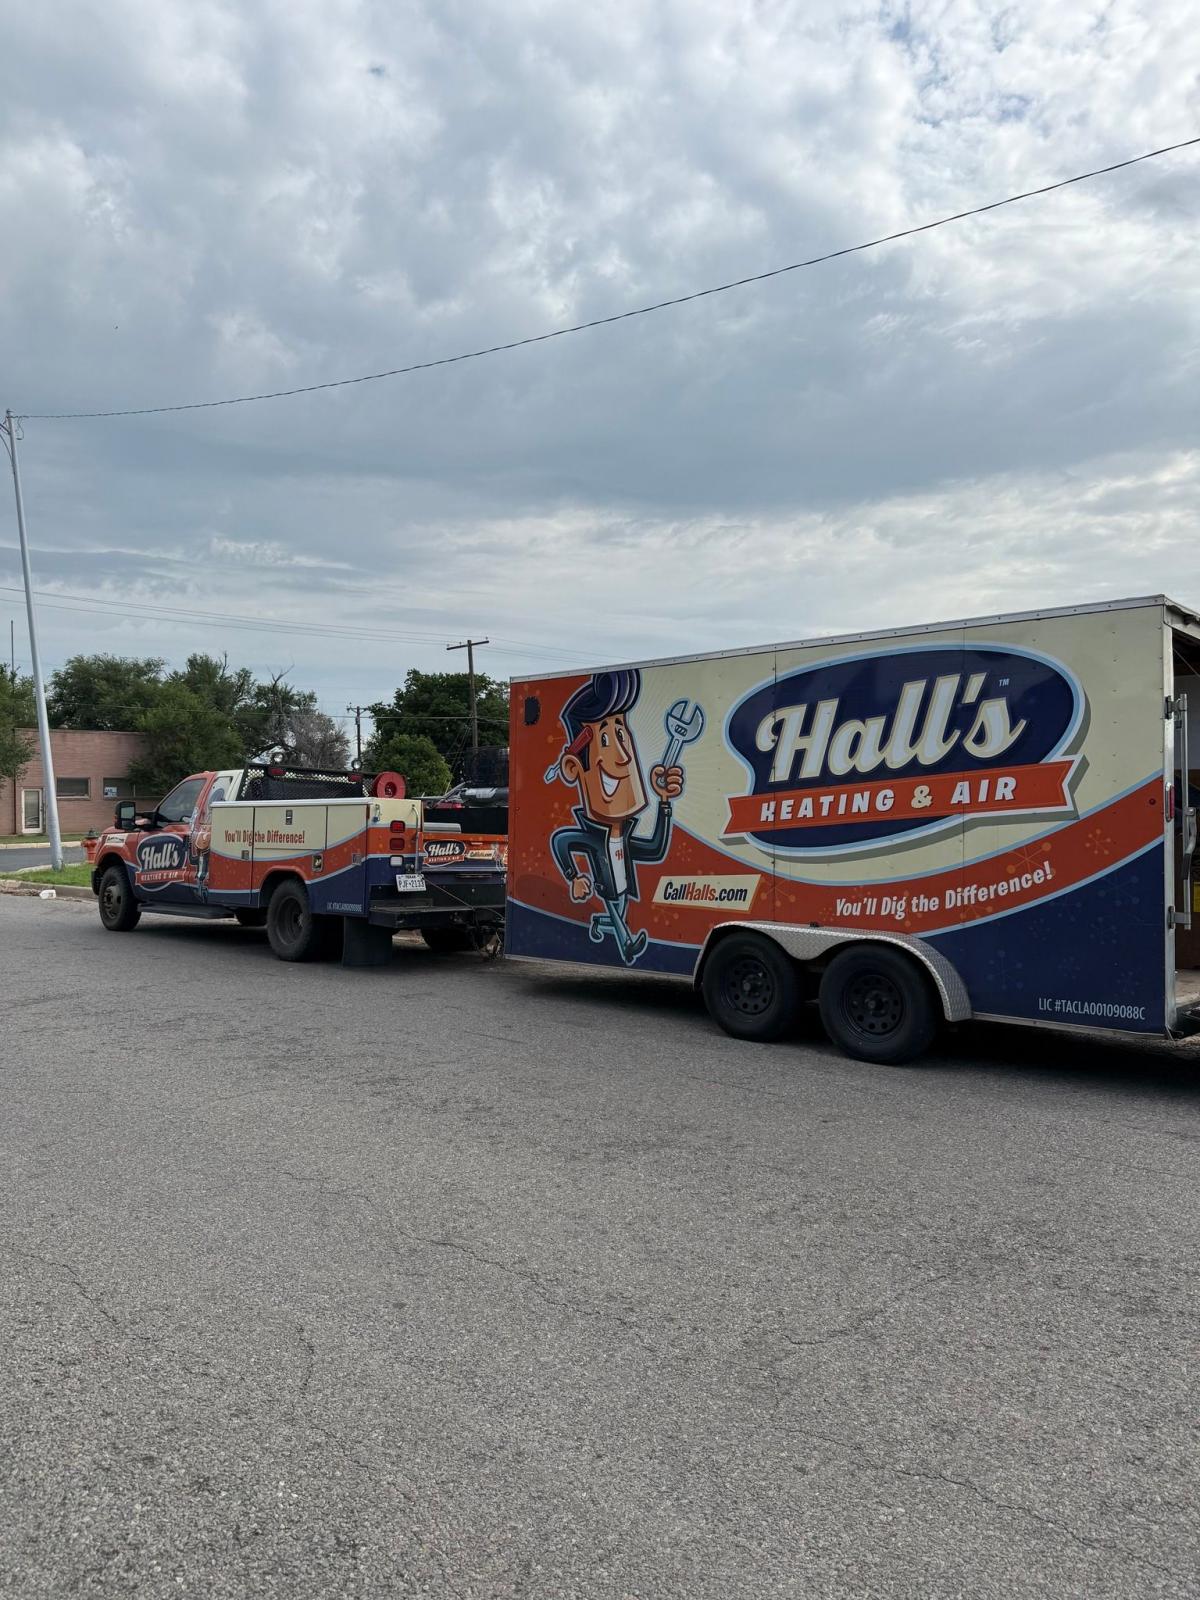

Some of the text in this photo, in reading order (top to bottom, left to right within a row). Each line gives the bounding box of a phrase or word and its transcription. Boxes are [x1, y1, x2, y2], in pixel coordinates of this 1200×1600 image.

[755, 671, 1027, 783] Hall's
[760, 776, 1018, 822] HEATING & AIR
[243, 830, 254, 846] Dig
[254, 831, 265, 843] the
[267, 830, 305, 844] Difference!
[428, 842, 461, 856] Hall's
[141, 843, 180, 870] Hall's
[663, 881, 748, 903] CallHalls.com
[835, 861, 1053, 921] You'll Dig the Difference!
[1038, 997, 1053, 1011] LIC
